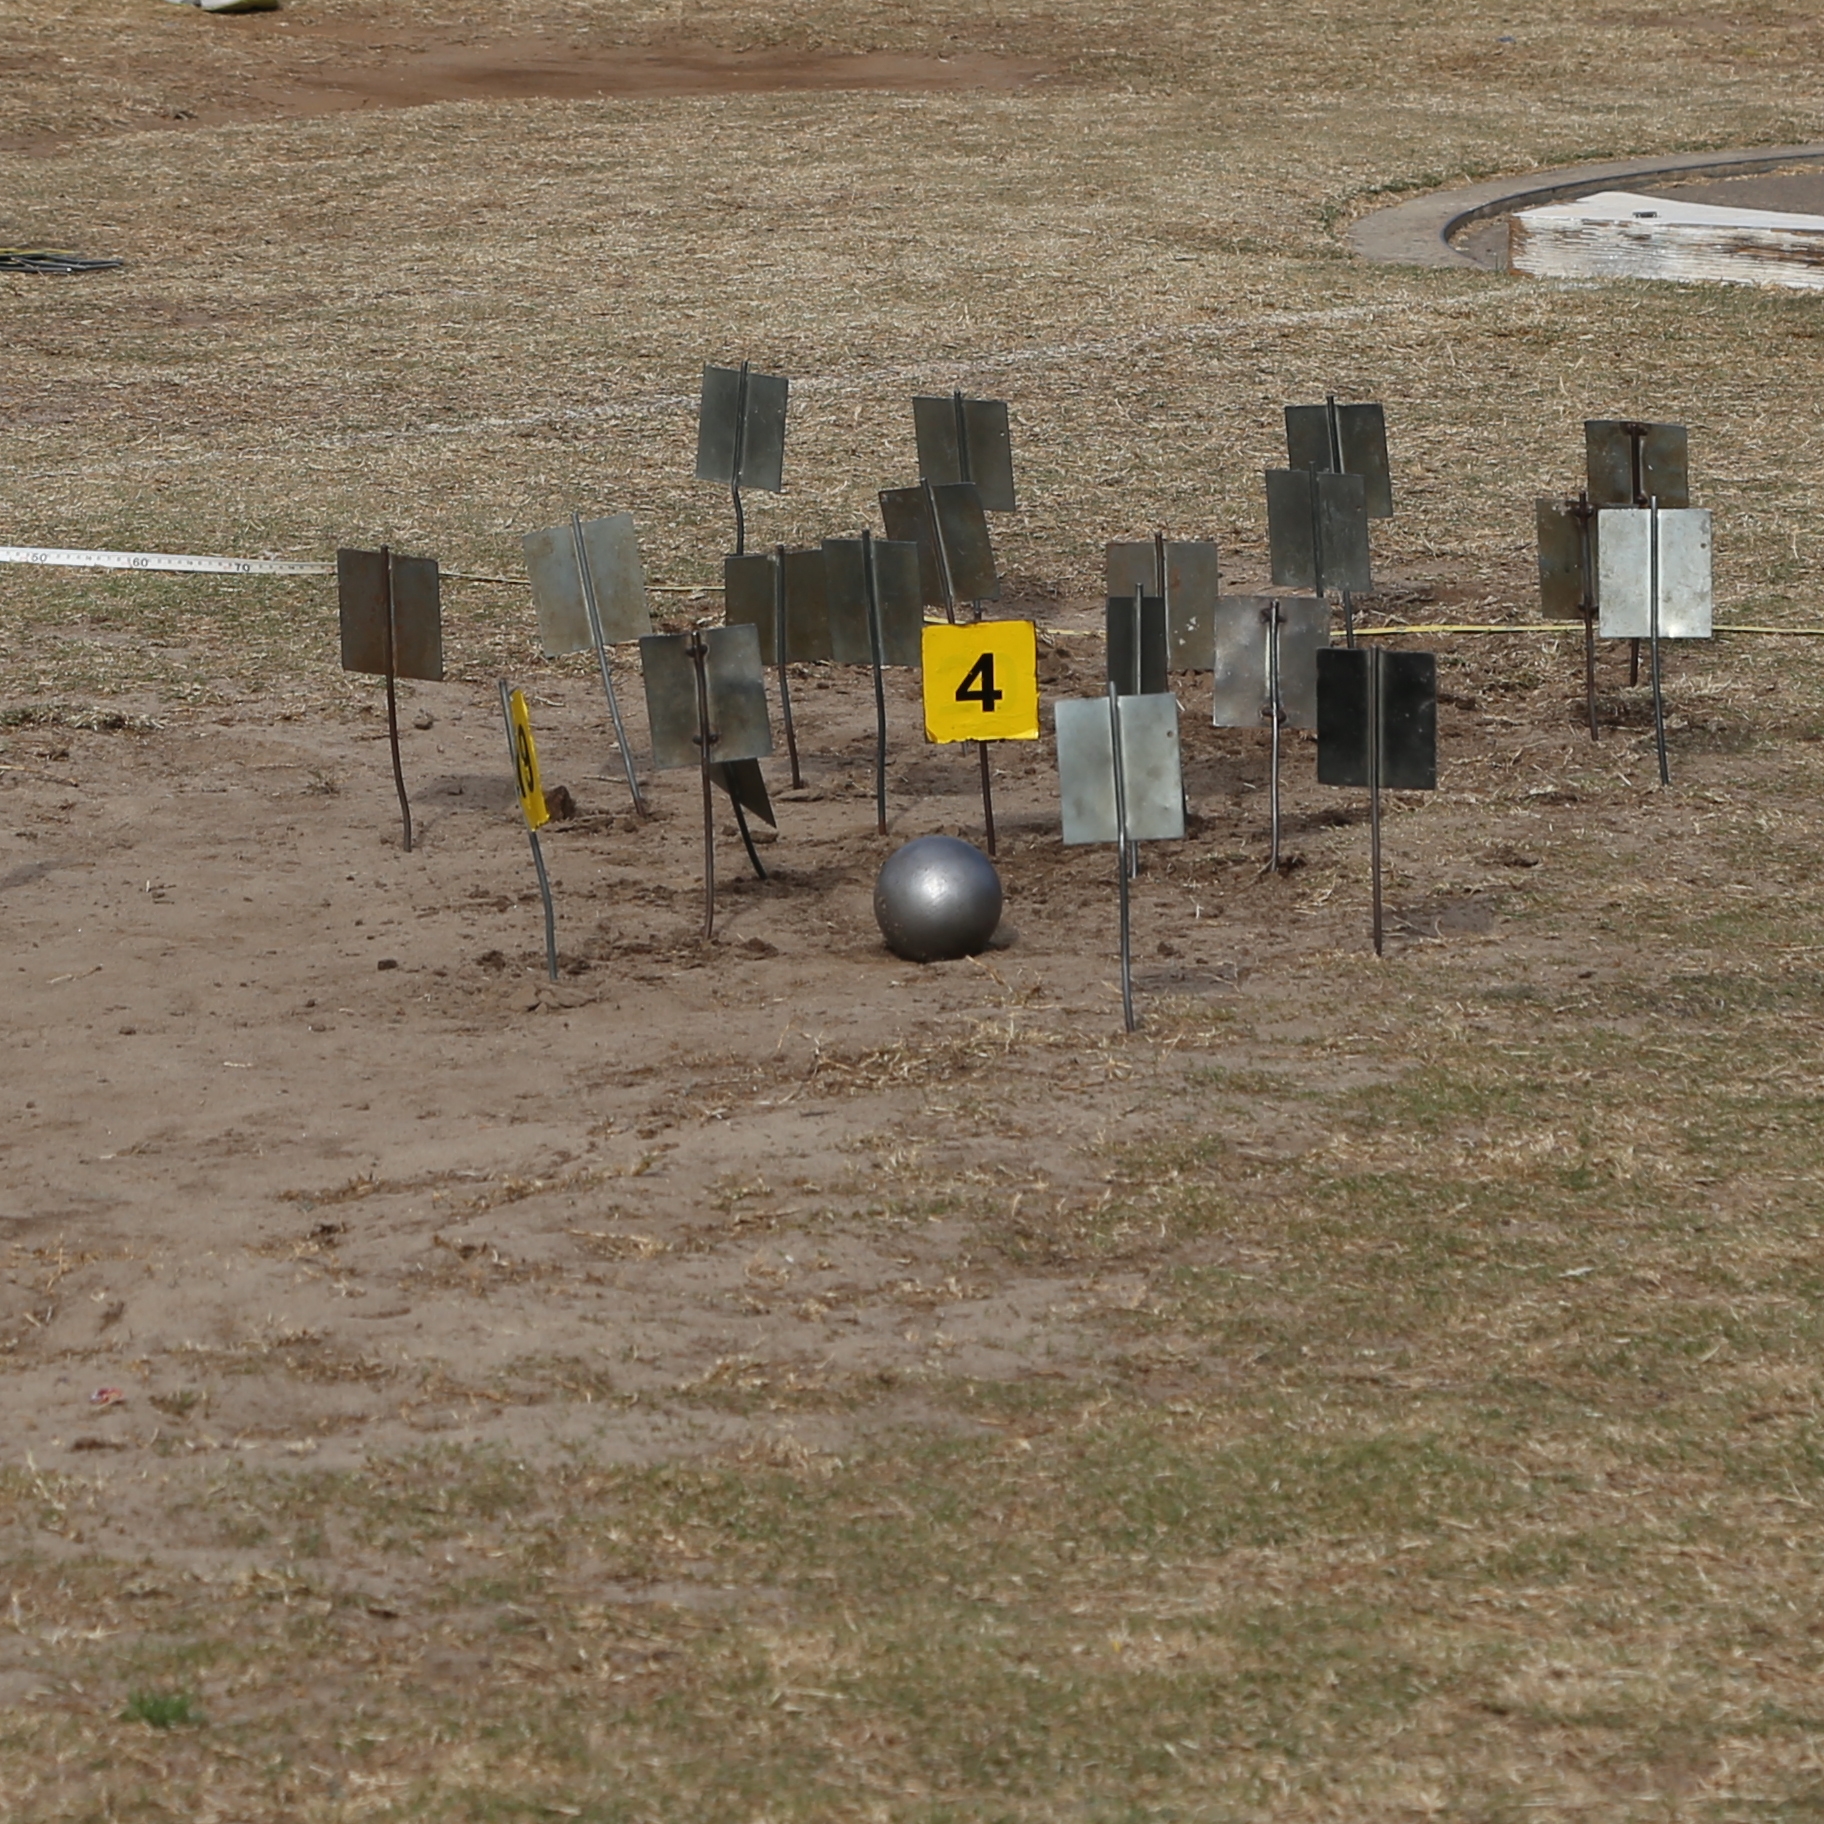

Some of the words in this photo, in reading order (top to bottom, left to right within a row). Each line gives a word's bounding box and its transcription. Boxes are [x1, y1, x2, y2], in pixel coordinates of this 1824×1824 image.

[31, 552, 47, 562] 50
[132, 557, 148, 567] 60
[234, 562, 251, 572] 70
[955, 652, 1003, 713] 4
